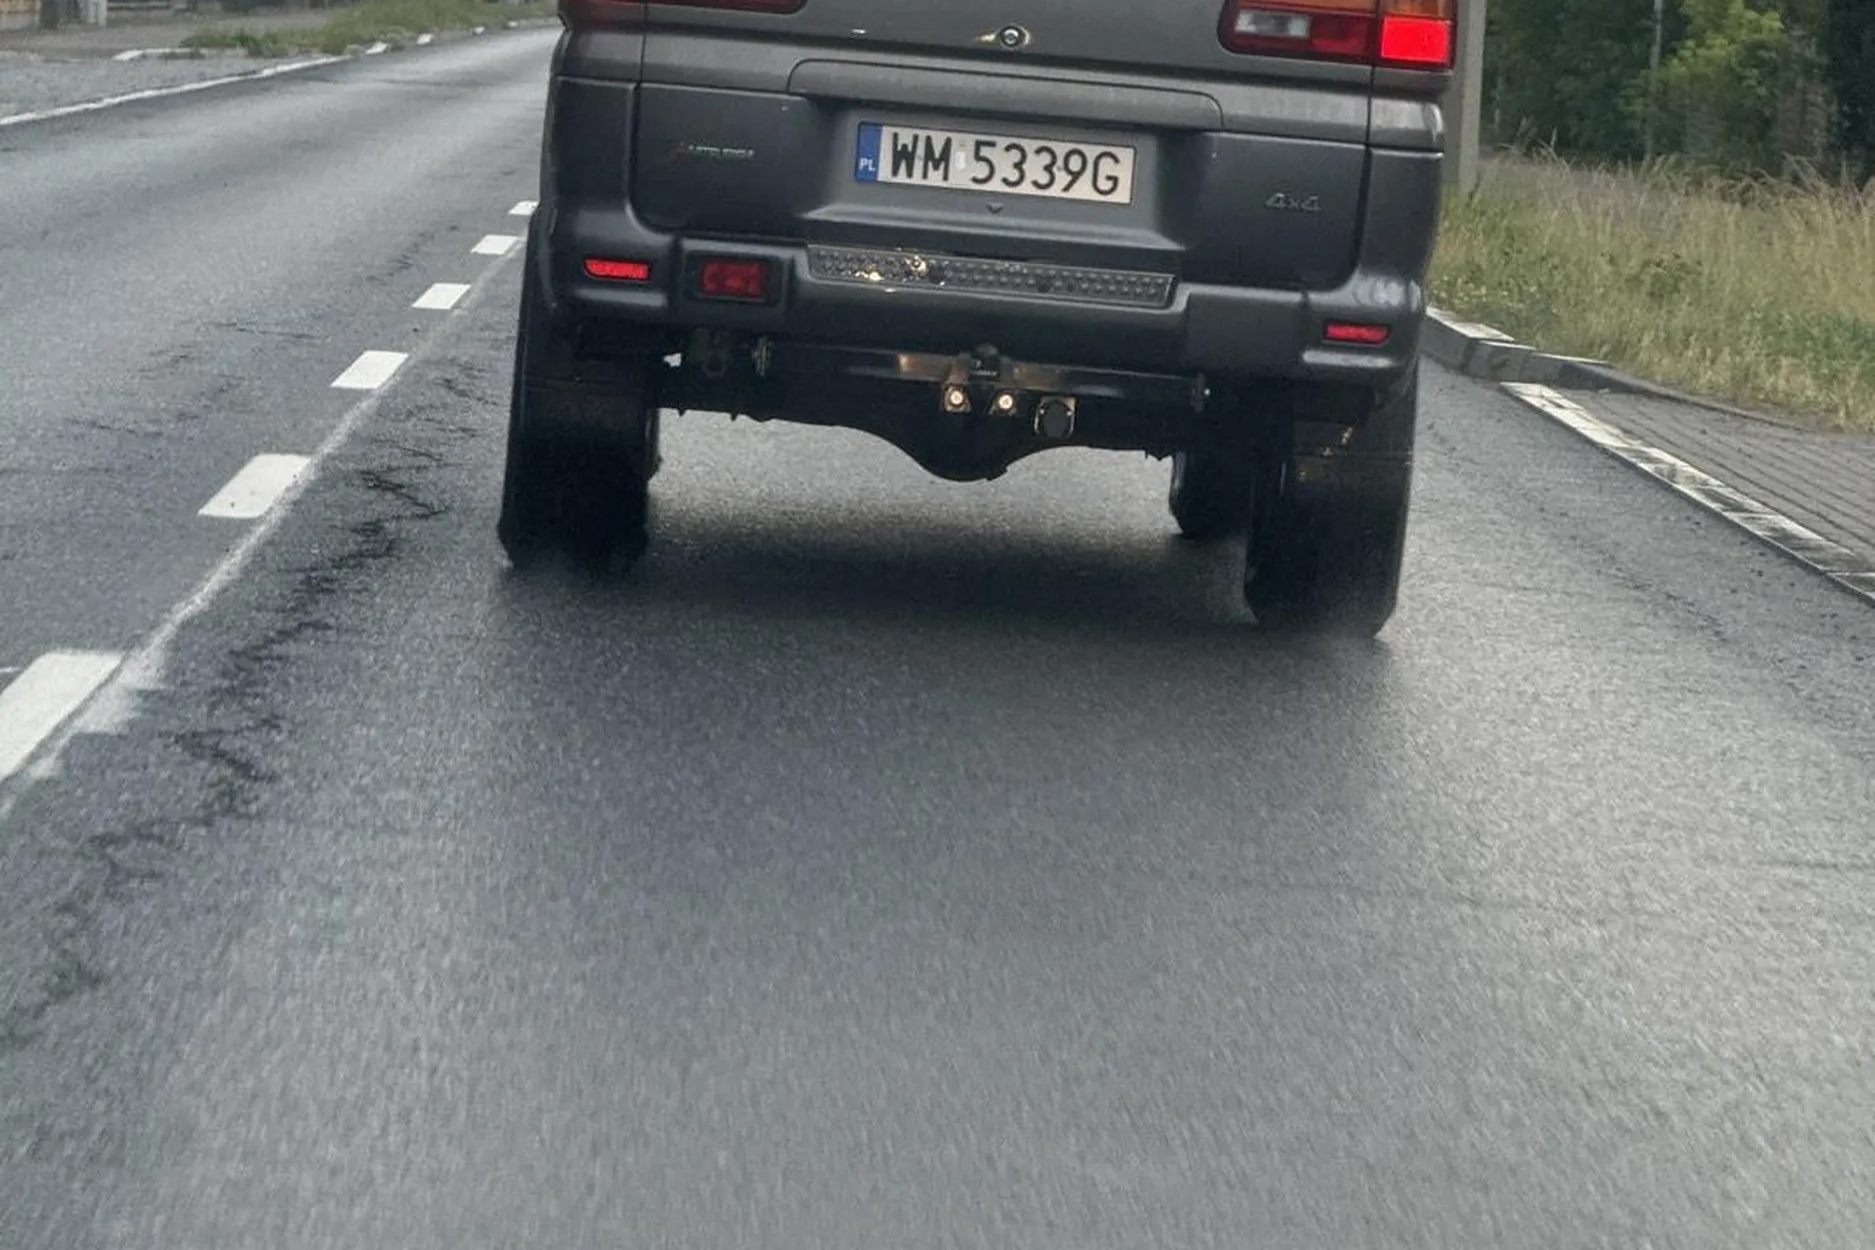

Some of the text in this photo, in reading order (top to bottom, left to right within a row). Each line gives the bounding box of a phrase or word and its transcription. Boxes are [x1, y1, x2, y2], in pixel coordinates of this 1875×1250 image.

[858, 157, 876, 172] PL
[890, 131, 1120, 196] WM 5339G
